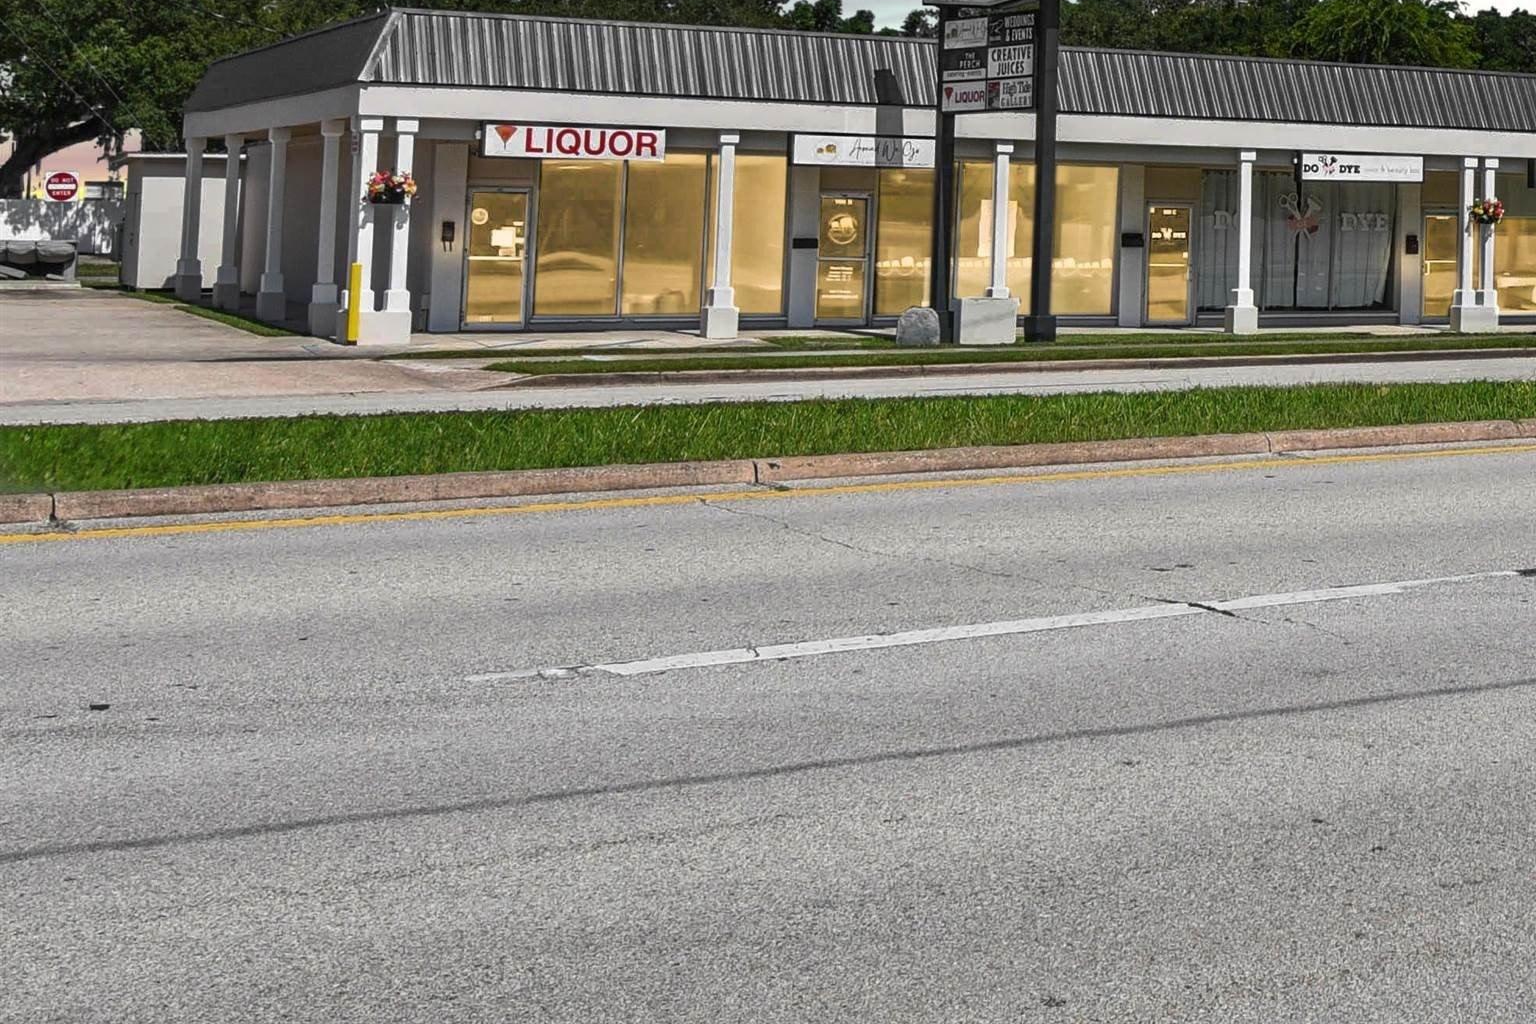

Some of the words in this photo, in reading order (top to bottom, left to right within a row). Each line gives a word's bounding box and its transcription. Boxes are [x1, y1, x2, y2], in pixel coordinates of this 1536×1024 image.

[1004, 13, 1035, 29] WEDDINGS
[1011, 27, 1033, 41] EVENTS
[964, 51, 976, 60] THE
[991, 45, 1032, 63] CREATIVE
[959, 59, 981, 69] PERCH
[996, 61, 1025, 76] JUICES
[954, 90, 985, 104] LIQUOR
[525, 127, 658, 157] LIQUOR
[1303, 163, 1319, 174] DO
[1339, 164, 1361, 174] DYE
[1214, 210, 1240, 230] D
[1340, 211, 1389, 232] DYE
